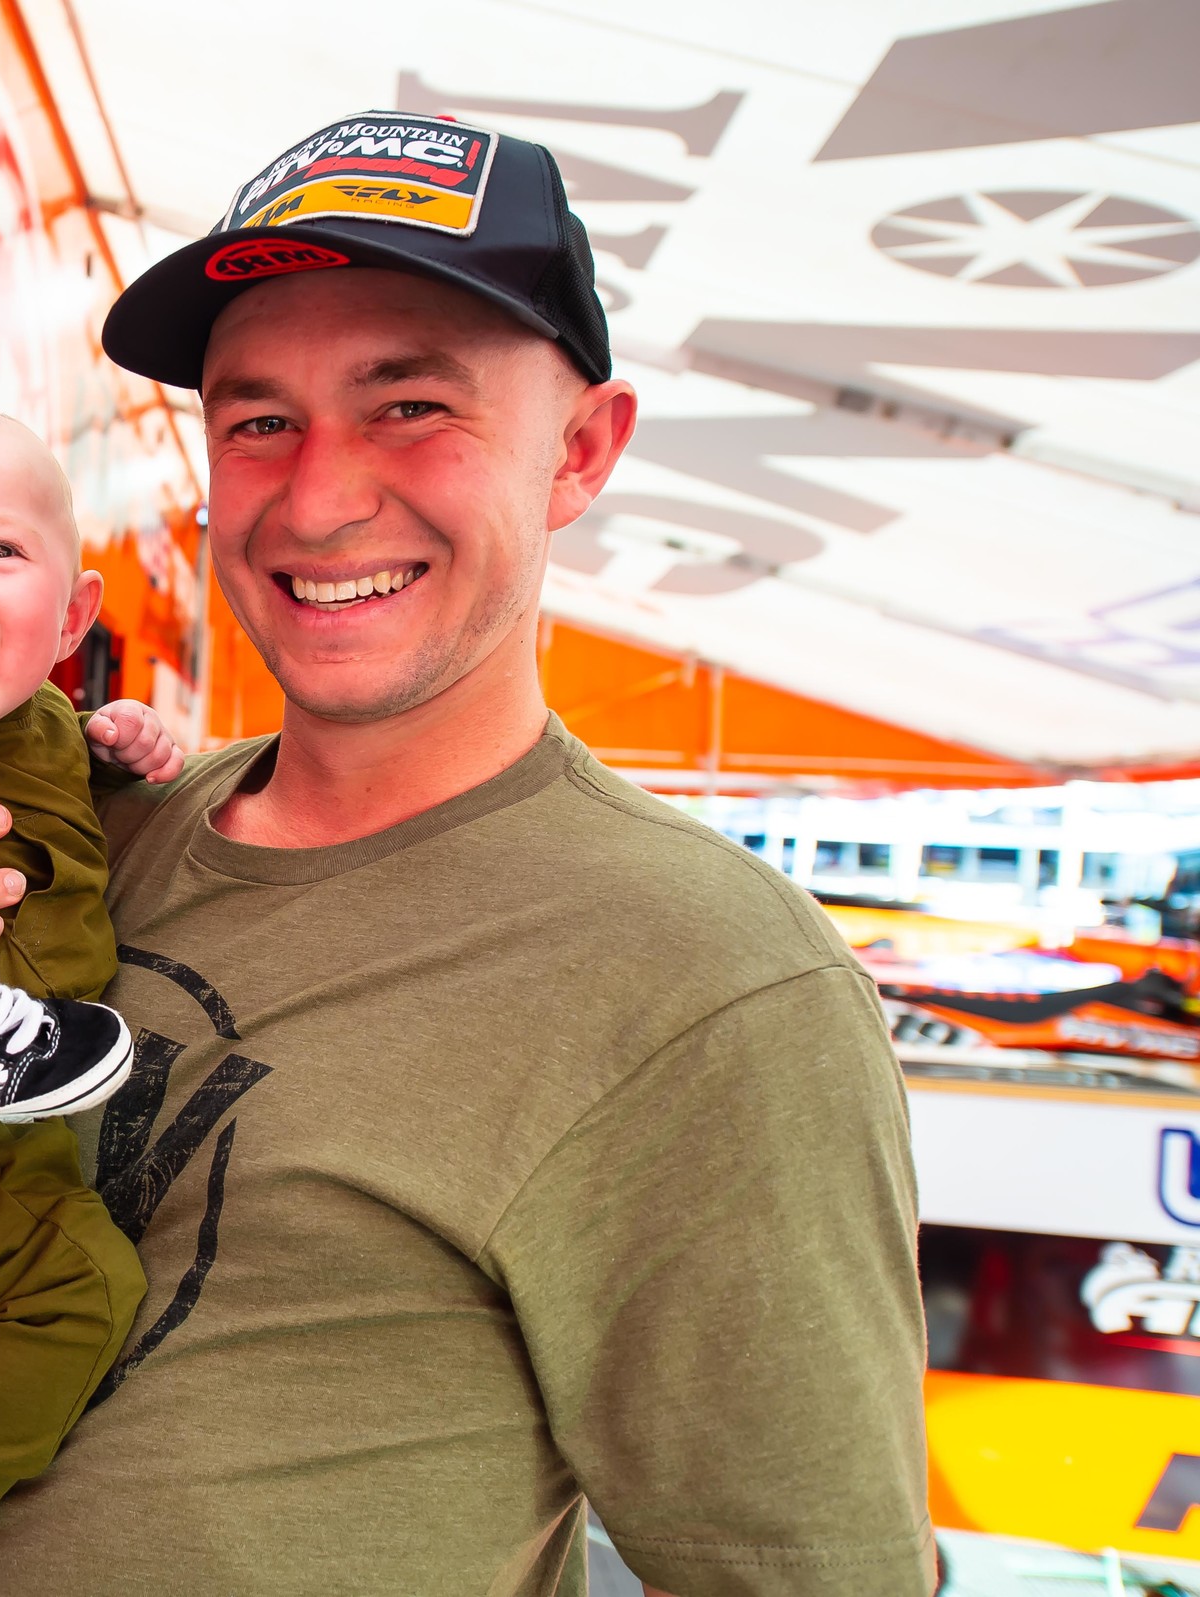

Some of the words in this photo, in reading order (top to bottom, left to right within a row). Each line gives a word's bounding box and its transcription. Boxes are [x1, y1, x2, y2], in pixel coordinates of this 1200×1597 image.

[266, 131, 332, 181] ROCKY
[331, 123, 468, 147] MOUNTAIN
[342, 185, 438, 204] FLY
[351, 198, 414, 209] RACING
